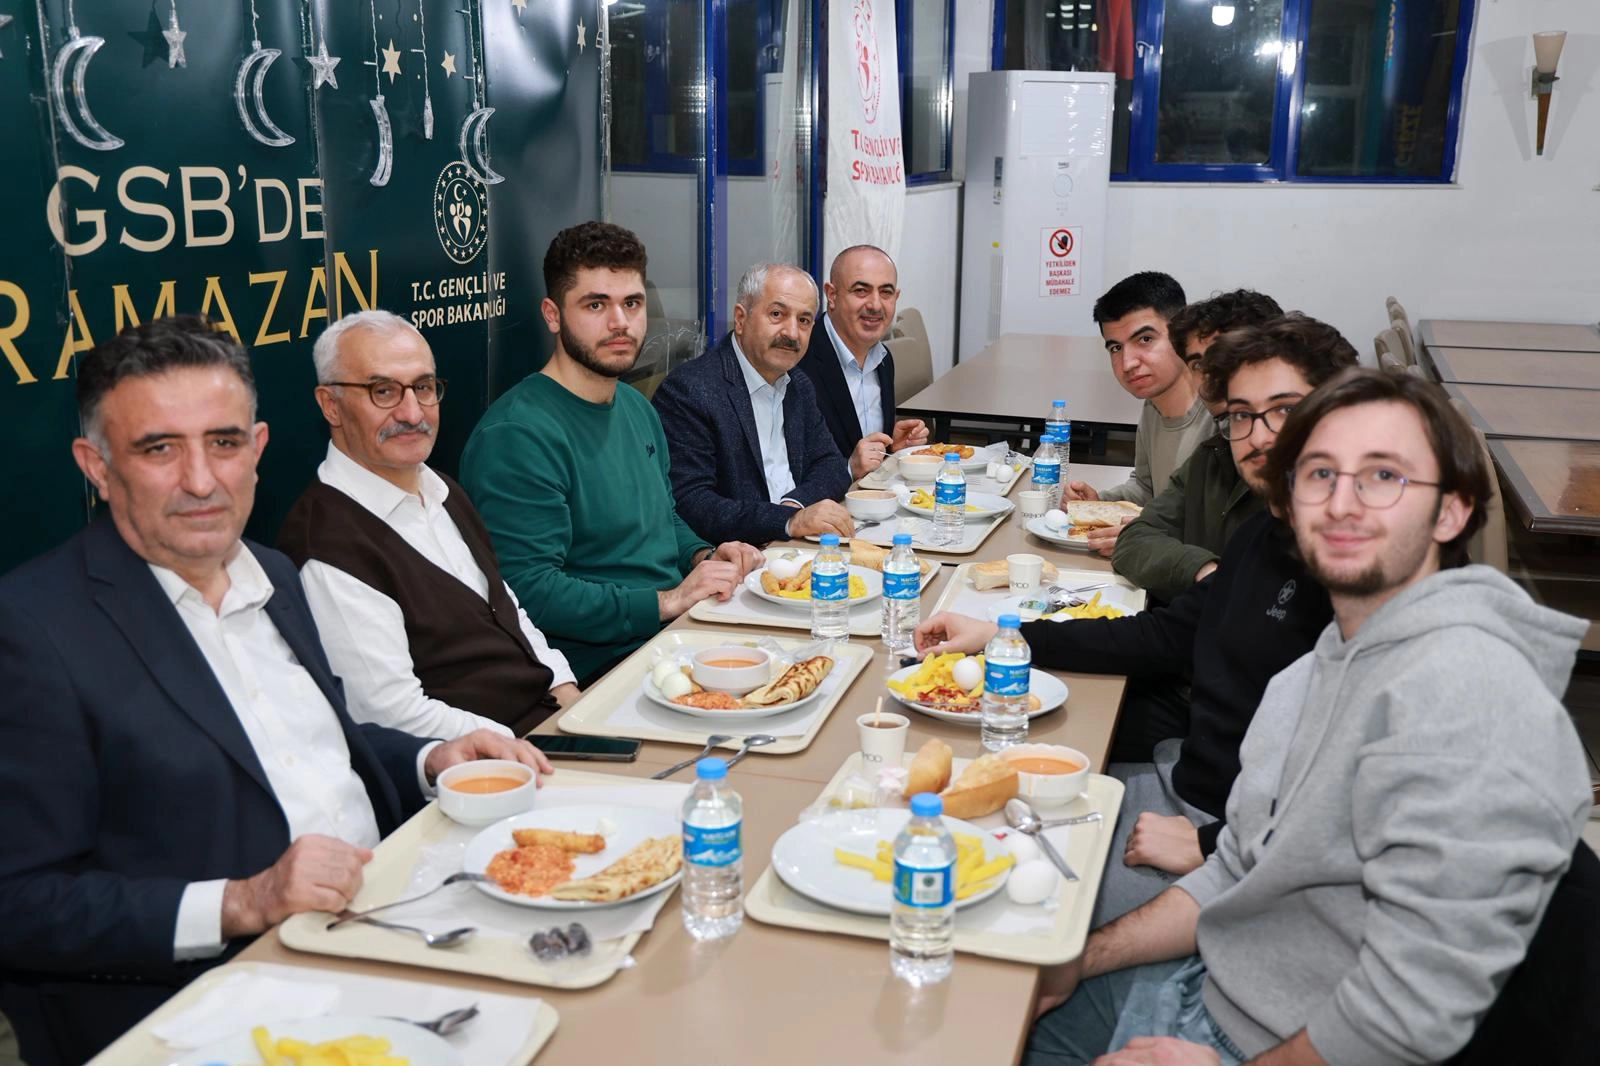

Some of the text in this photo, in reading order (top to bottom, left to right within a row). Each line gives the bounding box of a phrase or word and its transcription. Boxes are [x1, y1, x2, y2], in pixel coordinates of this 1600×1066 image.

[46, 165, 327, 256] GSB'DE
[0, 250, 378, 385] RAMAZAN
[411, 281, 435, 302] T.C.
[493, 272, 506, 292] VE
[411, 295, 506, 329] SPOR BAKANLIĞI
